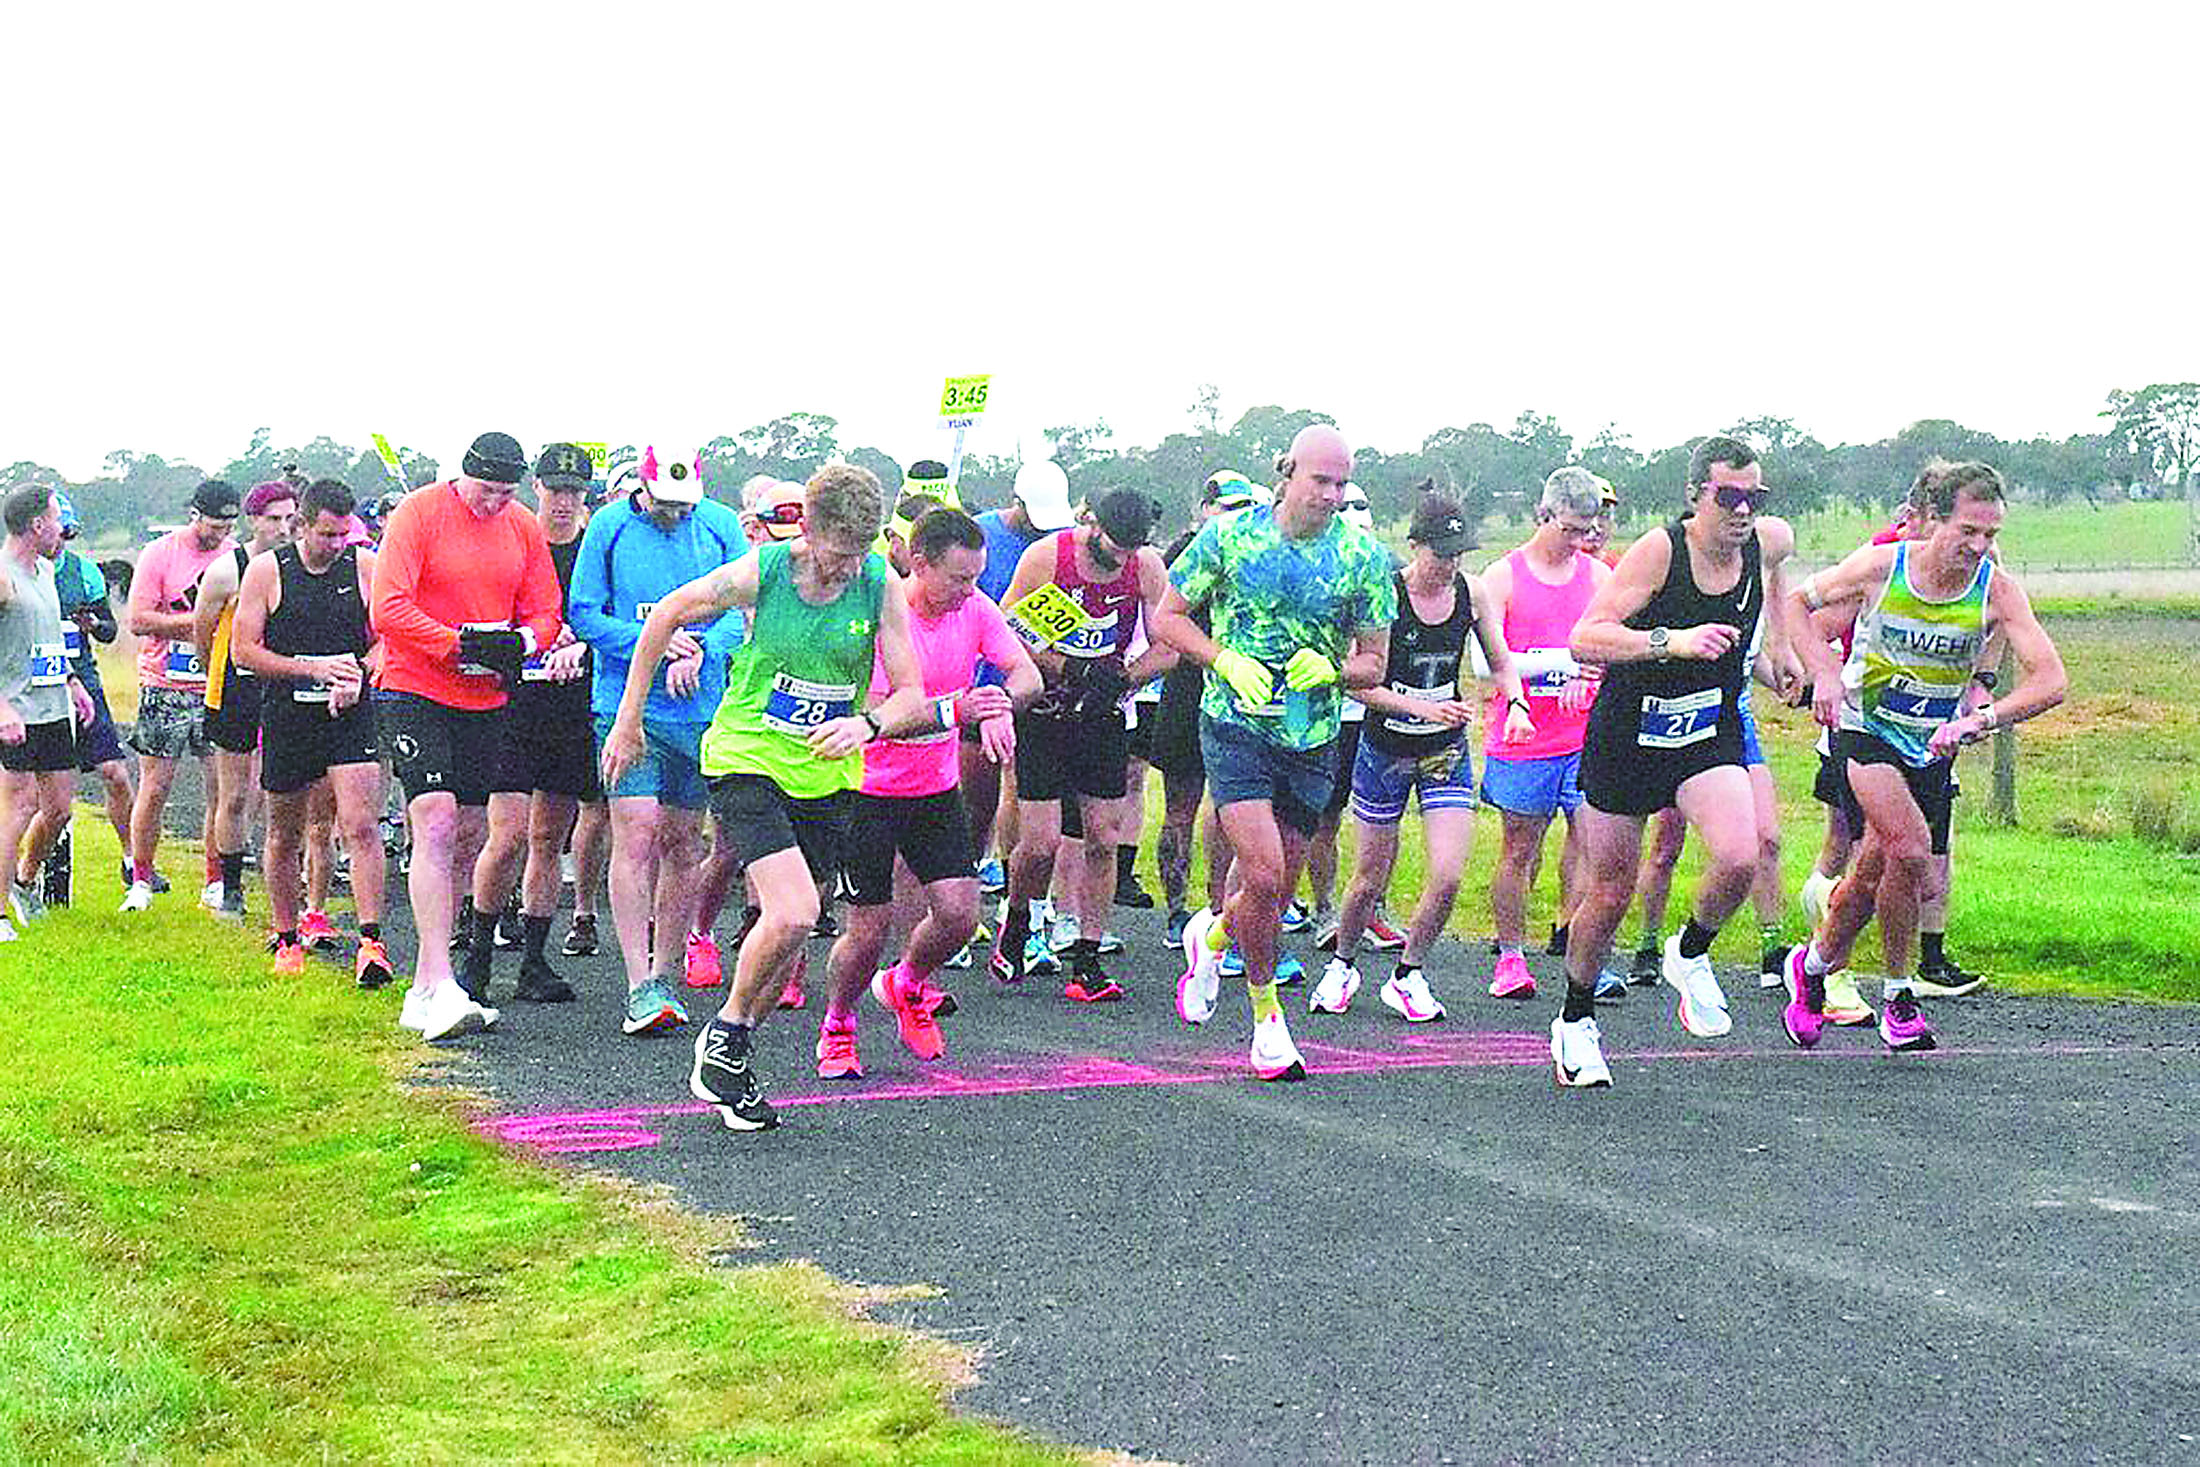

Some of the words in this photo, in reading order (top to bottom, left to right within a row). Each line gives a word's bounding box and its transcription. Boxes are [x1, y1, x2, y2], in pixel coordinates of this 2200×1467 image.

[945, 385, 988, 406] 3:45
[1028, 593, 1077, 633] 3:30
[1073, 629, 1104, 649] 30
[789, 699, 828, 725] 28
[1909, 698, 1930, 717] 4
[1666, 710, 1699, 736] 27
